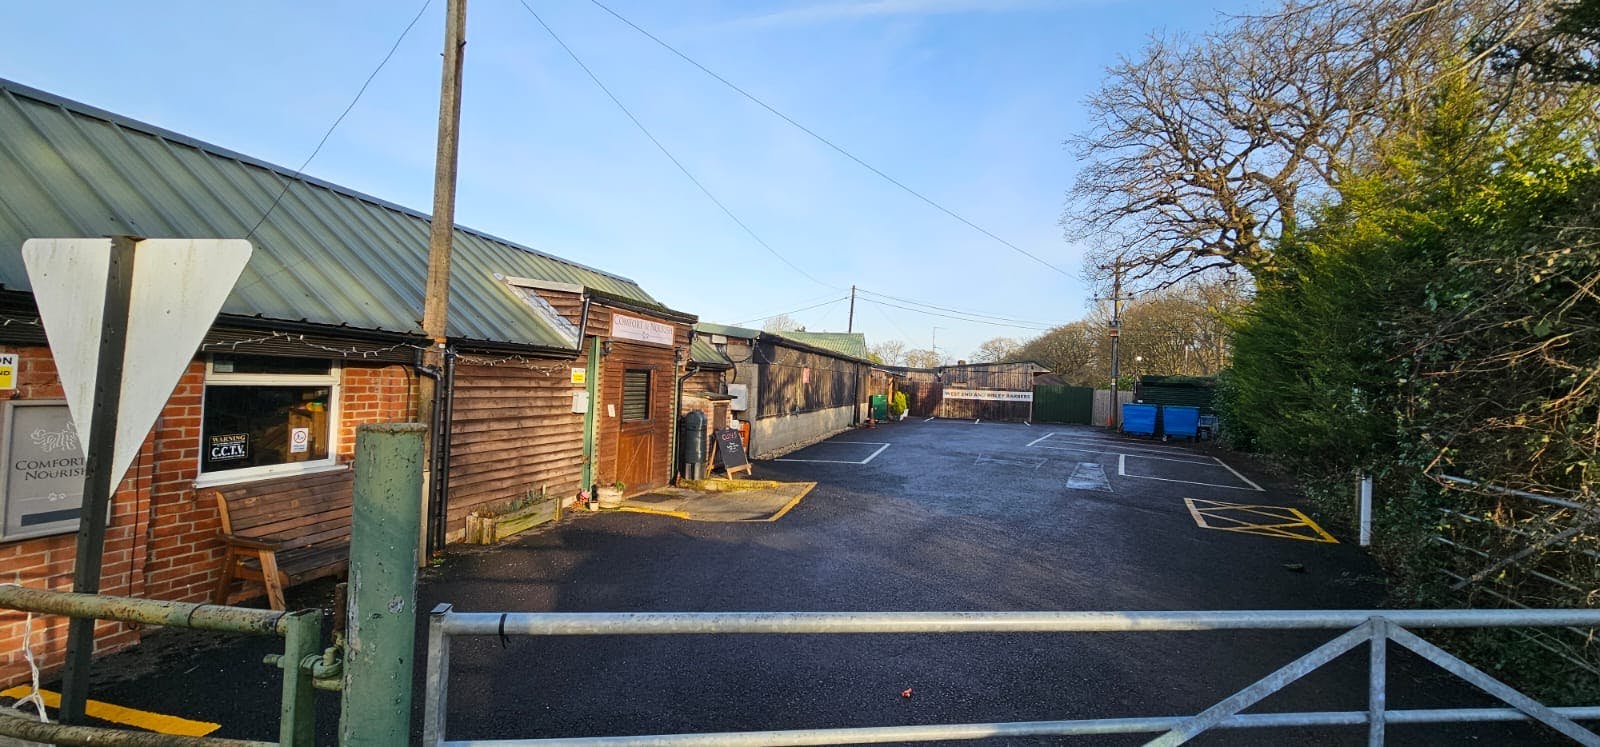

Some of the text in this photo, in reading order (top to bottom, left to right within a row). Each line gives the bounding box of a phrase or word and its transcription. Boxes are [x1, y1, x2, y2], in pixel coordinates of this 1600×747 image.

[614, 315, 643, 329] COMFORT
[212, 435, 246, 443] WARNING
[15, 458, 85, 471] COMFORT
